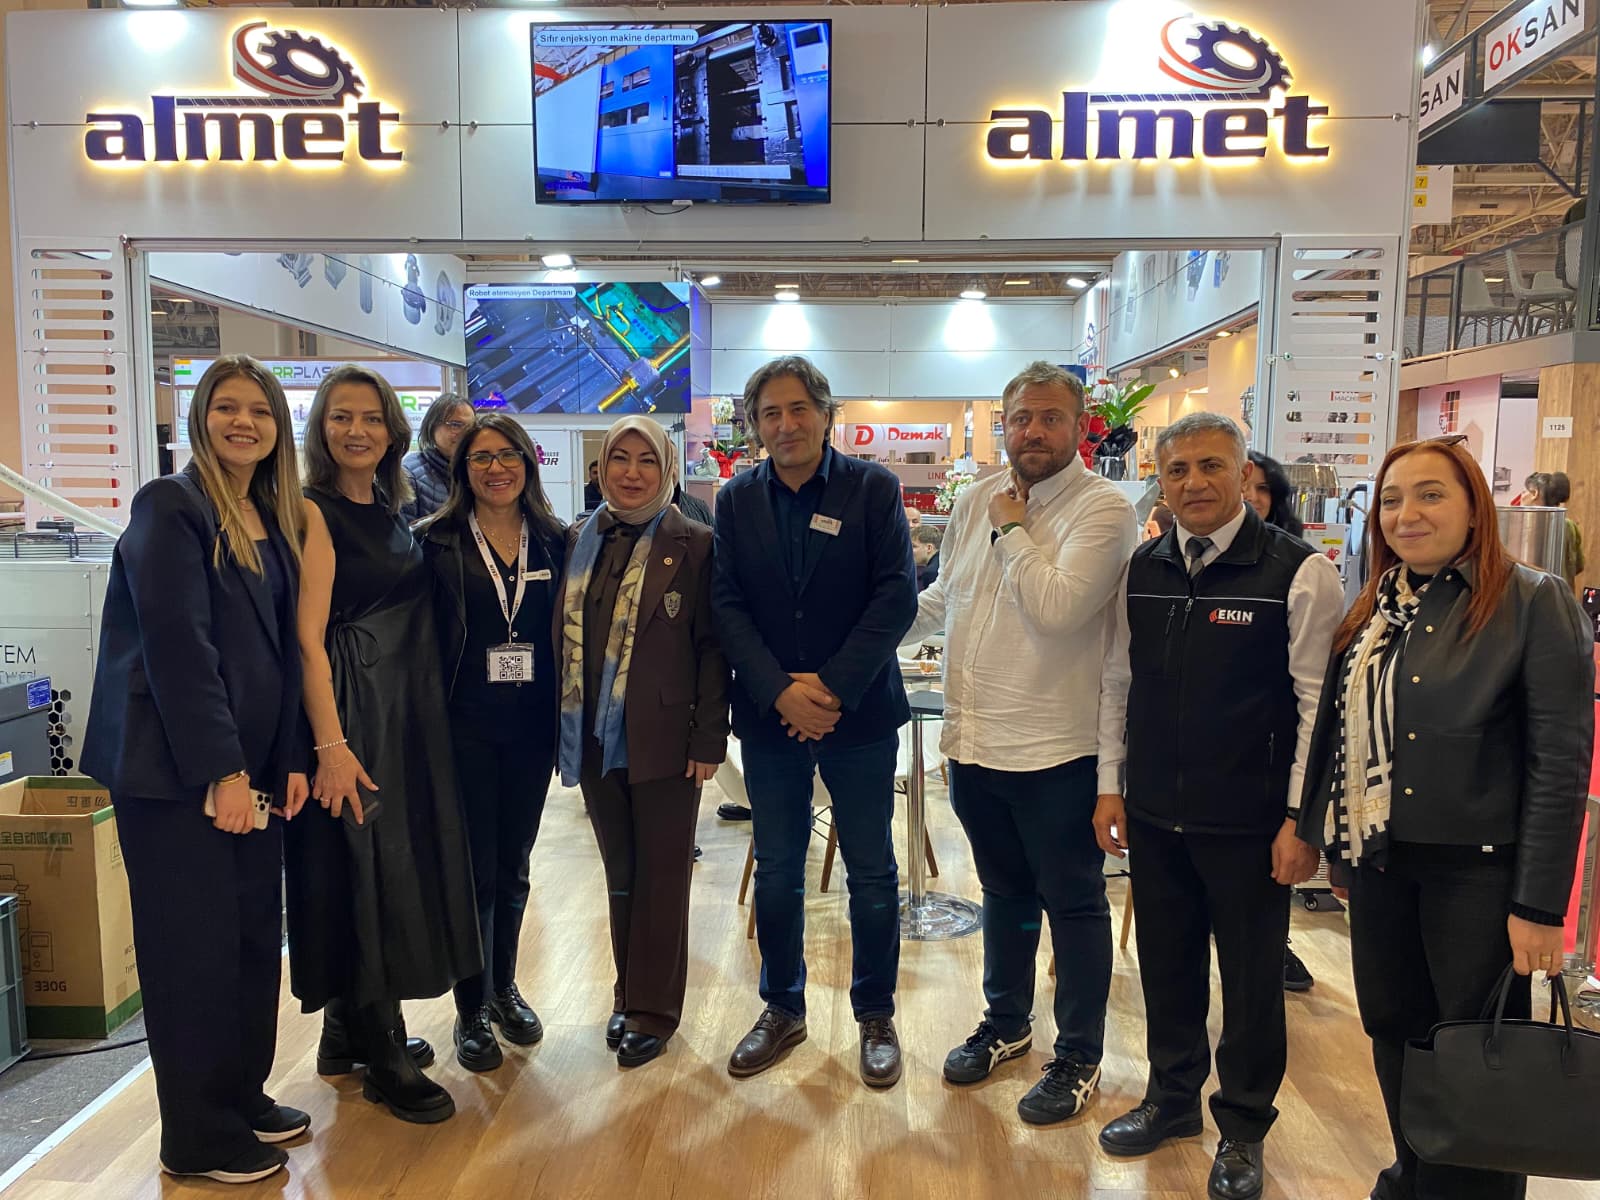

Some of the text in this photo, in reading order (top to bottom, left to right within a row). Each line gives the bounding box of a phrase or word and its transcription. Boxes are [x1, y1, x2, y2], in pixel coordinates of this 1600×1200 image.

[560, 33, 608, 44] enjeksiyon
[610, 33, 642, 42] makine
[1489, 0, 1579, 71] OKSAN
[1420, 69, 1460, 117] SAN
[84, 95, 403, 162] almet
[986, 91, 1329, 161] almet
[272, 366, 335, 379] RRPLAS
[1218, 609, 1253, 622] EKIN
[34, 981, 67, 992] 330G
